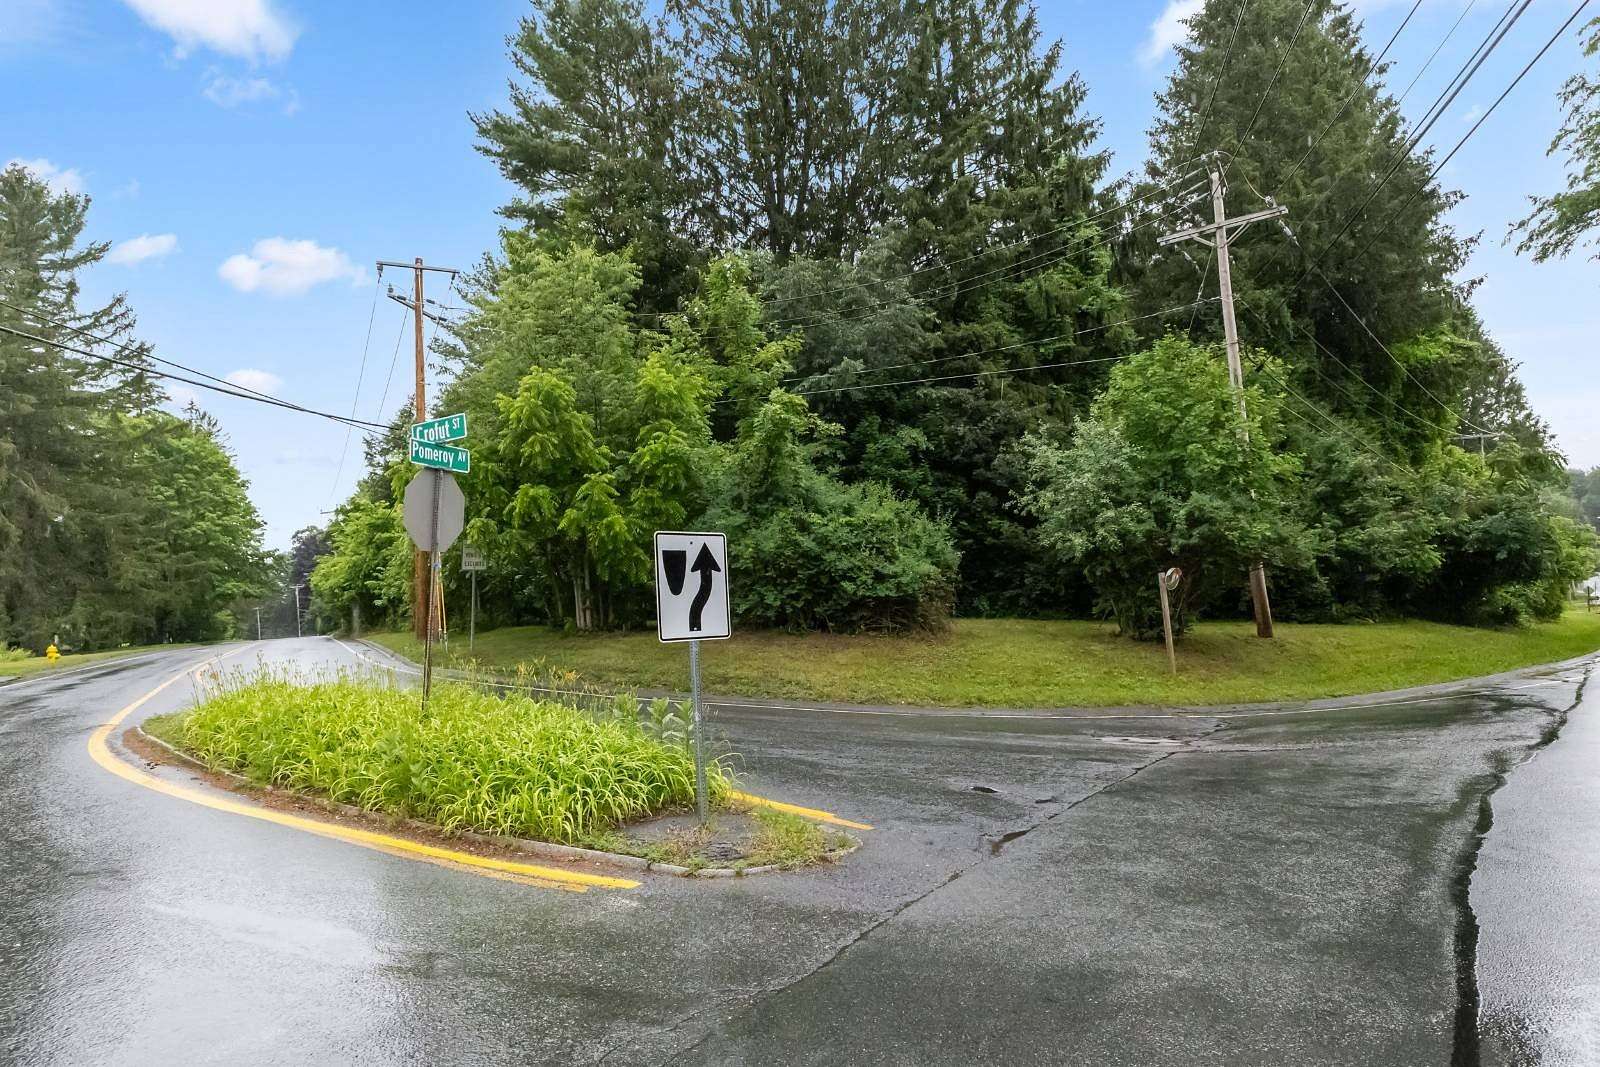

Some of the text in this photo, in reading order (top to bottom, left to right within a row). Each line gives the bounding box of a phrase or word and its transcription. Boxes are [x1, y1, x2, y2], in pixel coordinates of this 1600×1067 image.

[416, 418, 460, 441] Crofut ST
[413, 441, 454, 467] Pomeroy
